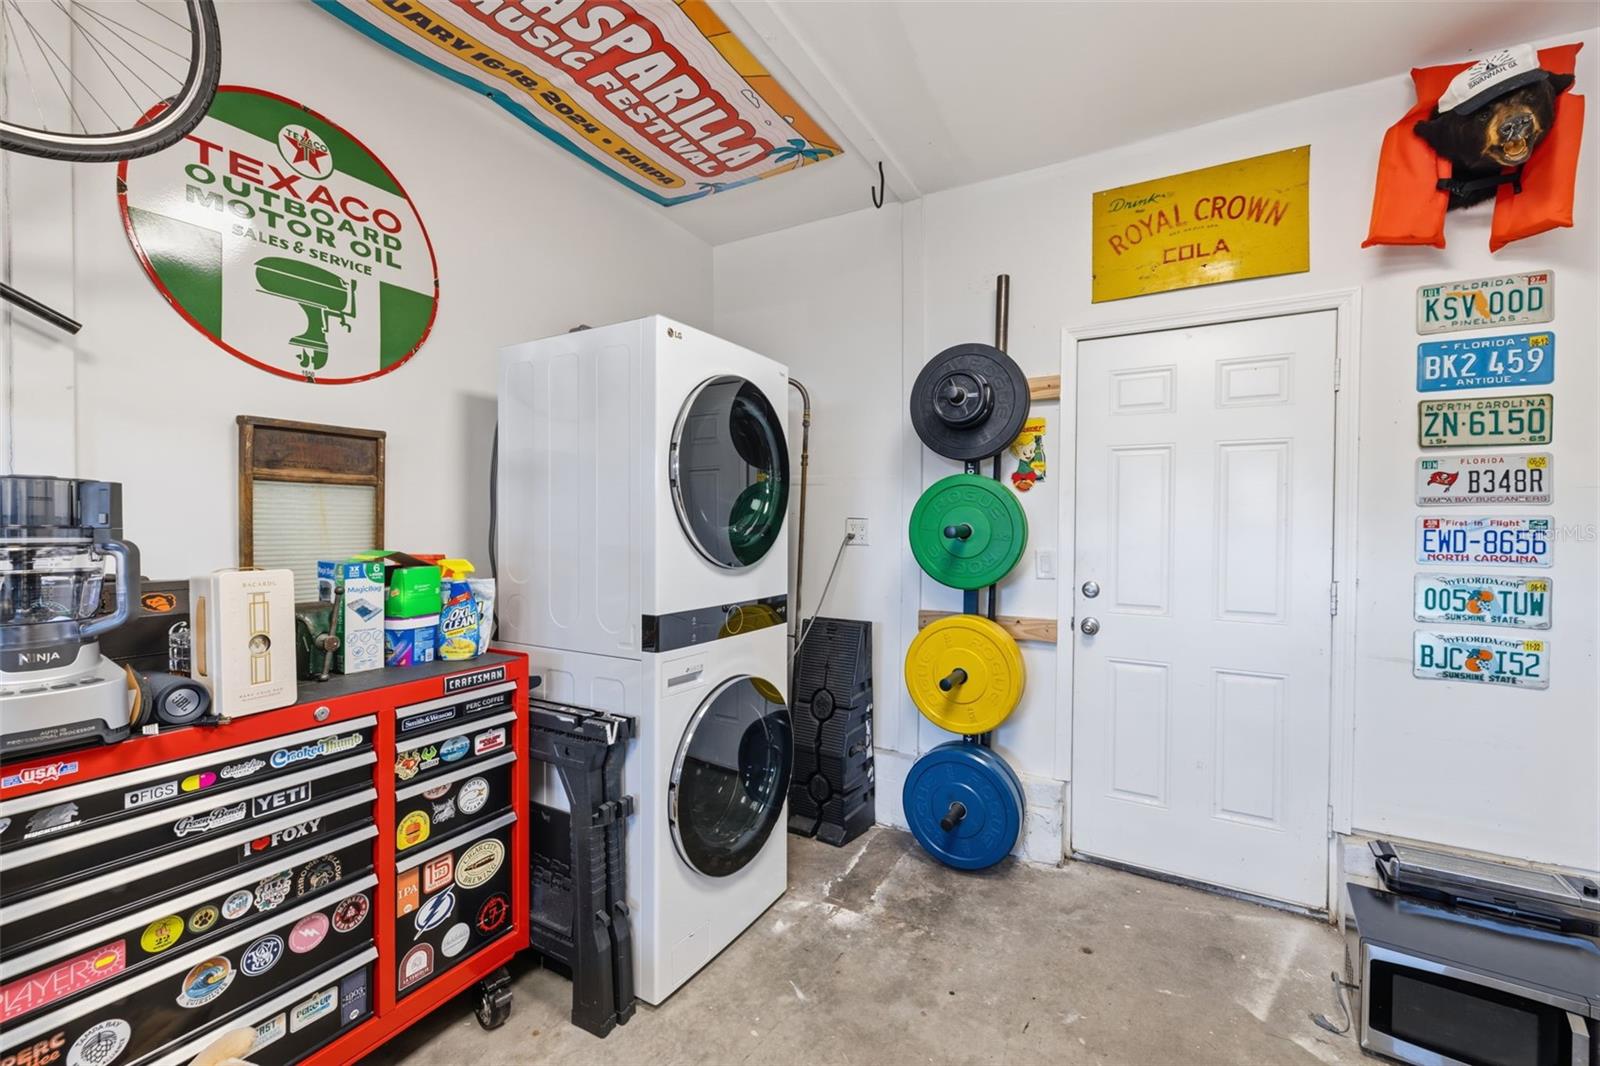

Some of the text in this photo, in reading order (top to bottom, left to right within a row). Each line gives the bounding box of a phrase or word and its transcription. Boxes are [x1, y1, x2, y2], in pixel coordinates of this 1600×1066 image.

[586, 71, 721, 174] FESTIVAL
[286, 128, 328, 153] TEXACO
[539, 91, 601, 134] 2024
[615, 147, 675, 186] TAMPA
[184, 133, 403, 235] TEXACO
[184, 163, 402, 252] OUTBOARD
[1107, 193, 1166, 213] Drink
[185, 183, 402, 270] MOTOR OIL
[1107, 195, 1290, 256] ROYAL CROWN
[231, 223, 373, 276] SALES & SERVICE
[1162, 239, 1231, 265] COLA
[1453, 278, 1515, 290] FLORIDA
[1425, 294, 1476, 323] KSV
[1451, 314, 1516, 327] PINELLAS
[1454, 338, 1516, 350] FLORIDA
[1424, 348, 1544, 380] BK2 459
[1456, 375, 1512, 386] ANTIQUE
[1426, 398, 1546, 412] NORTH CAROLINA
[1460, 457, 1505, 465] FLORIDA
[1468, 468, 1543, 493] B348R
[1423, 495, 1547, 504] TAMPA BAY BUCCANEERS
[1446, 519, 1468, 527] First
[1490, 519, 1520, 528] Flight
[1423, 529, 1547, 555] EWD-8656
[373, 563, 380, 572] 6
[1427, 554, 1538, 564] NORTH CAROLINA
[1444, 577, 1520, 589] MYFLORIDA.COM
[451, 607, 470, 620] OXI
[1498, 591, 1545, 617] TUW
[443, 614, 475, 632] CLEAN
[1445, 613, 1519, 624] SUNSHINE STATE
[1444, 635, 1520, 648] MYFLORIDA.COM
[1525, 642, 1541, 651] 11-22
[19, 652, 60, 666] NINJA
[1420, 644, 1463, 670] BJC
[449, 669, 503, 690] CRAFTSMAN
[1441, 671, 1517, 684] SUNSHINE STATE
[172, 693, 191, 712] JBL
[466, 695, 504, 710] PERC COFFEE
[59, 726, 96, 737] PROCESSOR
[271, 734, 361, 767] Crooked Thumb
[24, 765, 58, 781] USA
[140, 784, 174, 802] FIGS
[256, 786, 306, 811] YETI
[175, 816, 210, 834] Green
[210, 803, 245, 821] Bench
[243, 818, 320, 857] I FOXY
[463, 864, 497, 883] BREWING
[0, 960, 89, 1013] LAYER
[75, 1024, 104, 1048] TAMPA
